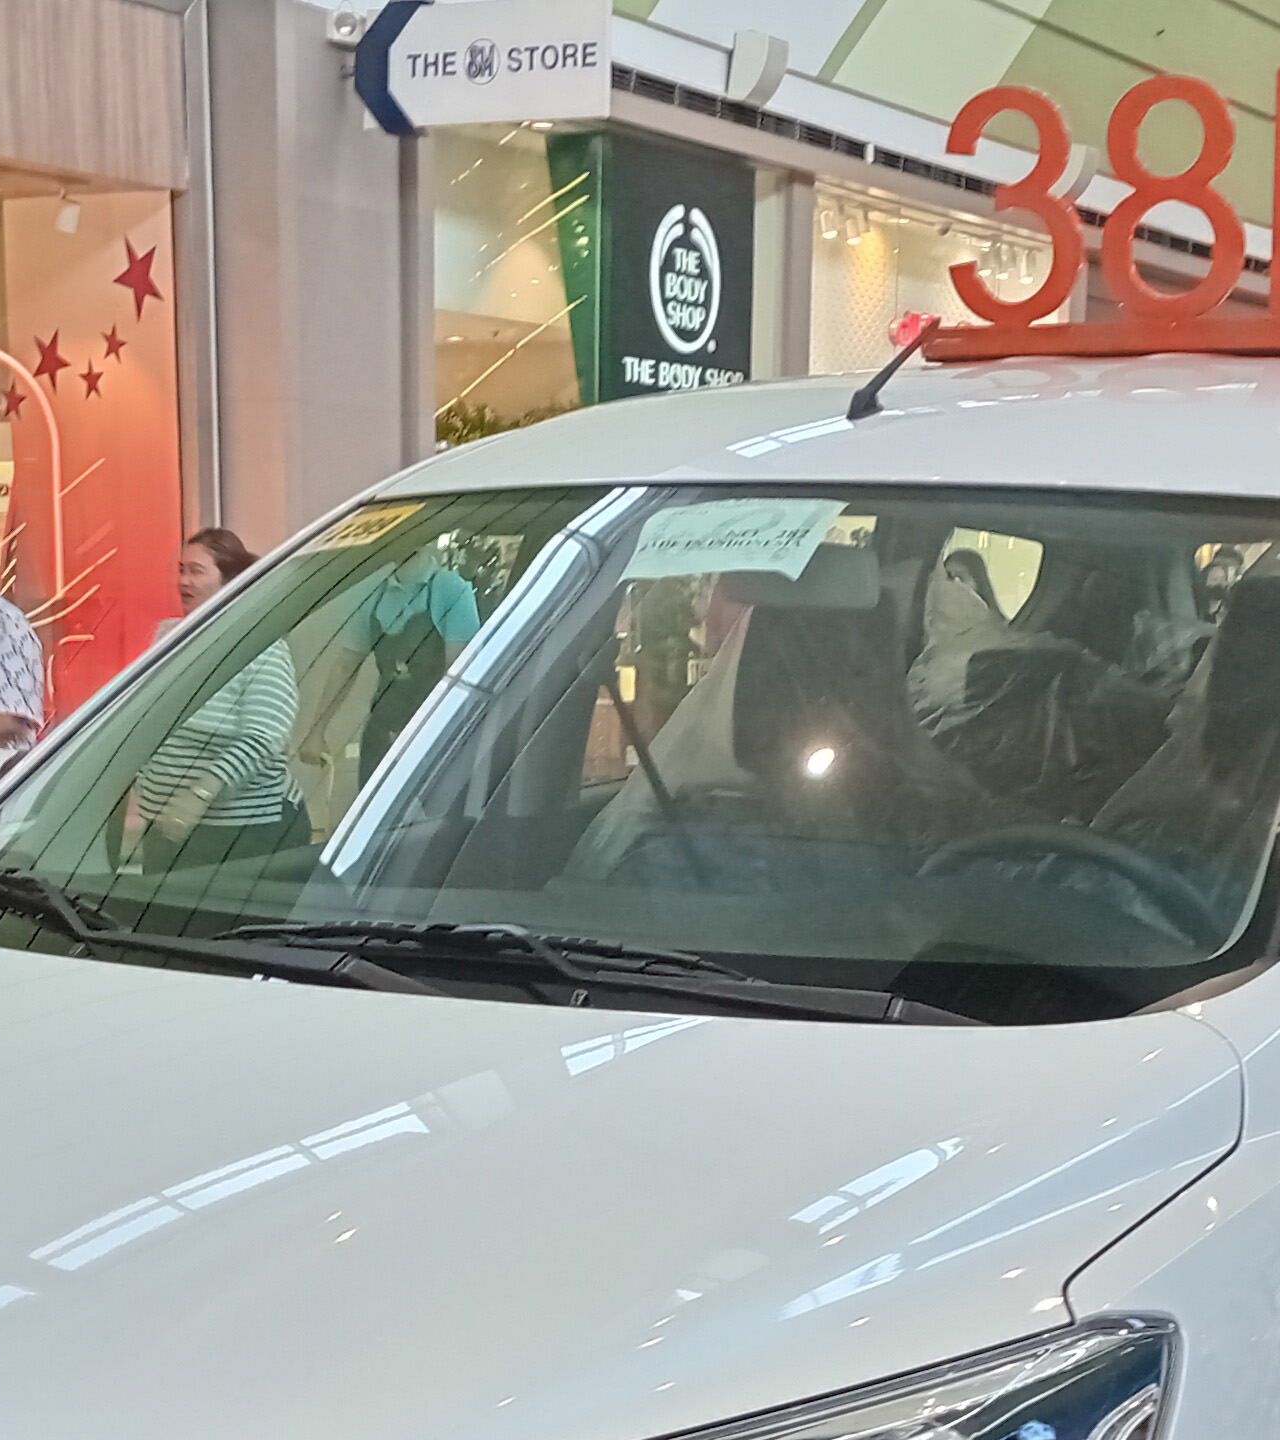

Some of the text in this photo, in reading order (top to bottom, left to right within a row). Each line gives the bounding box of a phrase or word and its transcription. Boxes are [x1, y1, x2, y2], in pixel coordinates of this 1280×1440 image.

[407, 51, 457, 78] THE
[507, 42, 598, 73] STORE
[672, 248, 701, 275] THE
[664, 272, 709, 304] BODY
[666, 300, 707, 331] SHOP
[621, 356, 656, 386] THE
[658, 361, 703, 389] BODY
